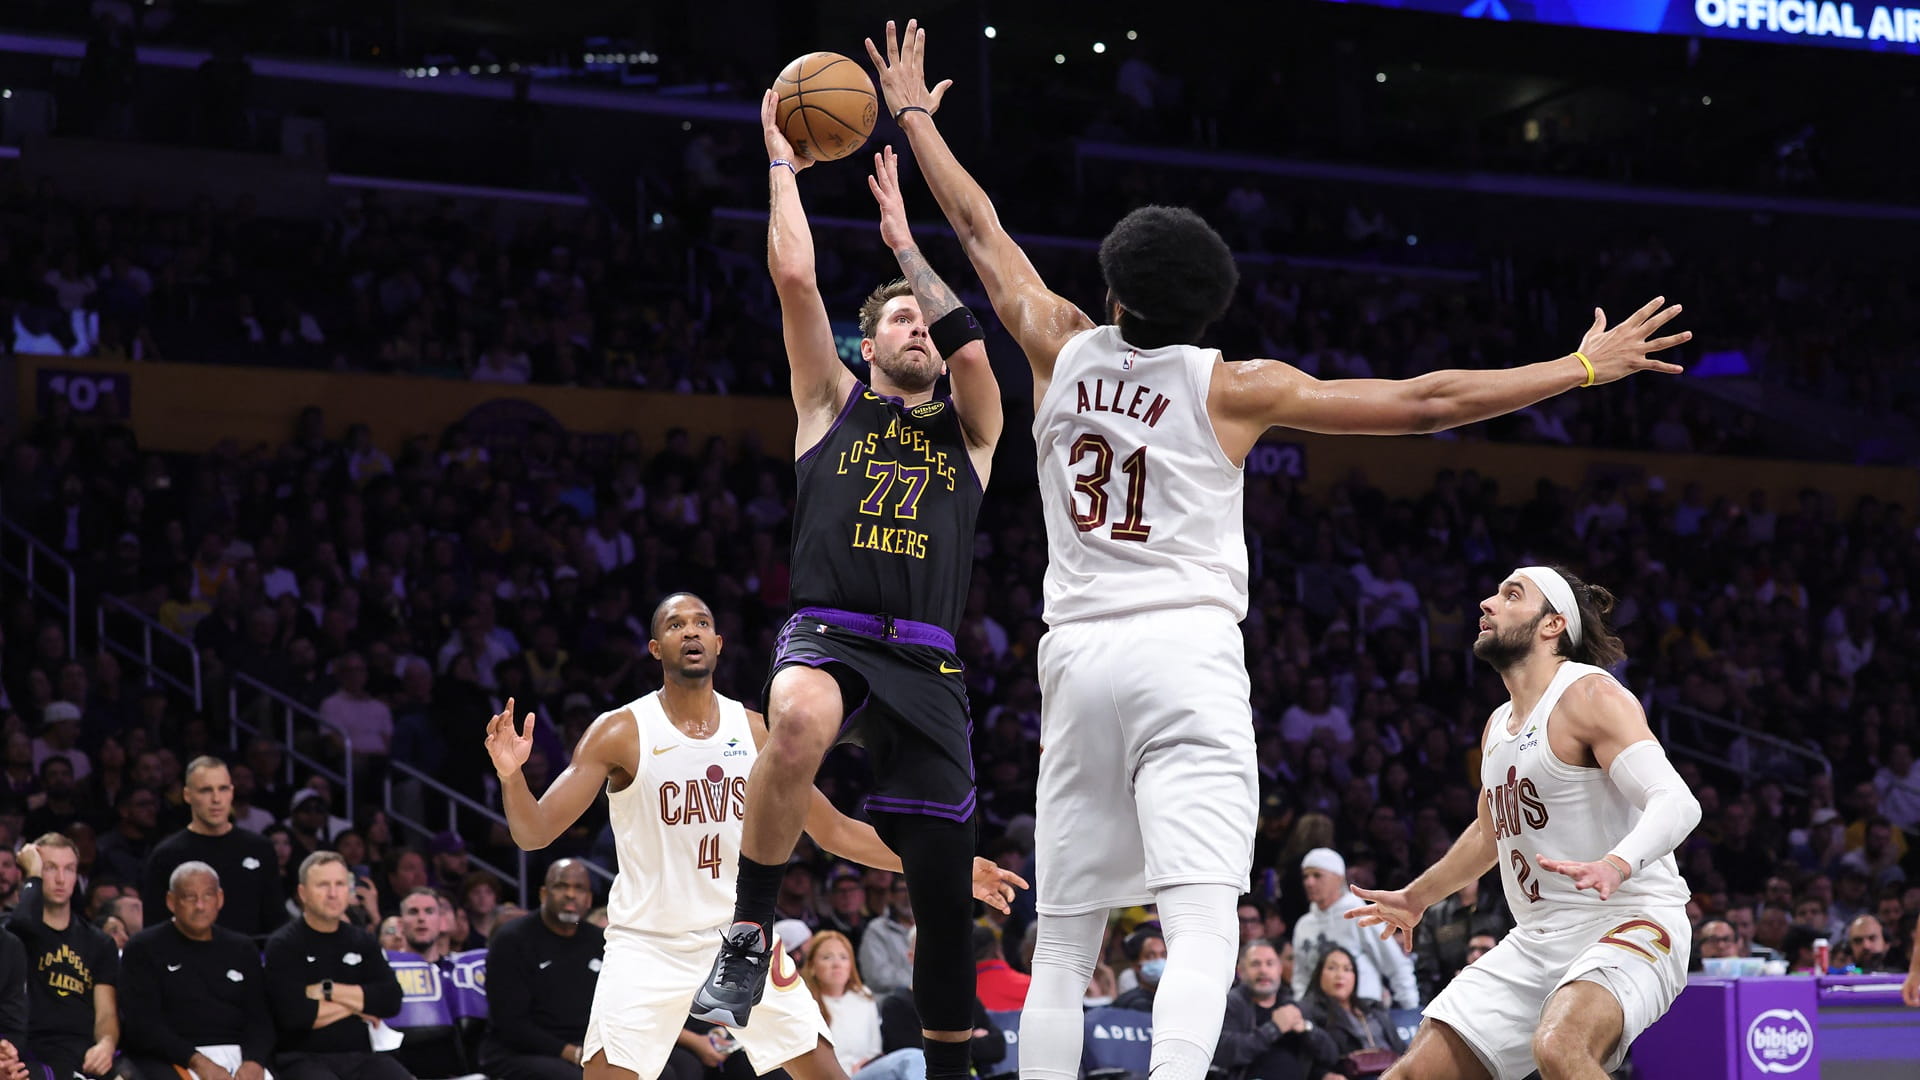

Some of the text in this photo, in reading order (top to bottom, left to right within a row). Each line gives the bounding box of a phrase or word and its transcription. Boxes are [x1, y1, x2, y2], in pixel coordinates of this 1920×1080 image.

[1695, 0, 1864, 39] OFFICIAL
[1077, 378, 1171, 429] ALLEN
[837, 417, 956, 492] LOS AGELES
[860, 459, 929, 520] 77
[1068, 433, 1152, 543] 31
[853, 523, 928, 559] LAKERS
[723, 749, 748, 757] CLIFFS
[659, 776, 747, 826] CAVS
[697, 833, 722, 879] 4
[1511, 849, 1544, 903] 2
[1110, 1025, 1153, 1041] DEL
[1754, 1025, 1808, 1055] bibigo
